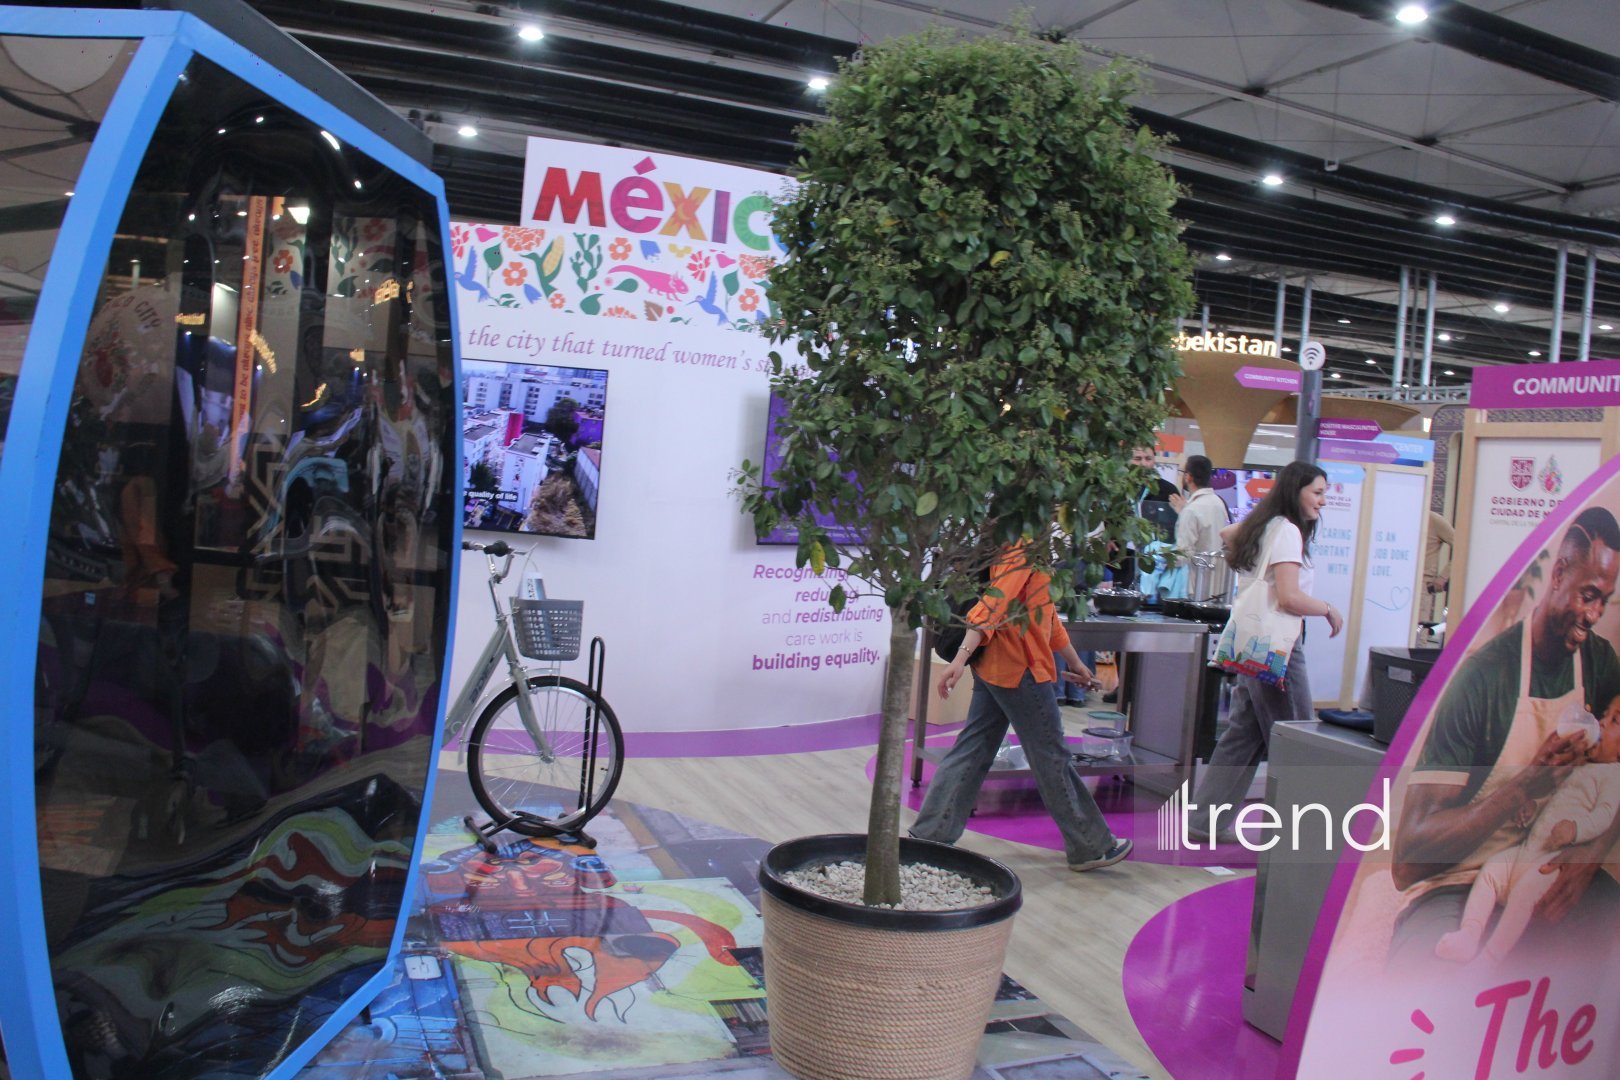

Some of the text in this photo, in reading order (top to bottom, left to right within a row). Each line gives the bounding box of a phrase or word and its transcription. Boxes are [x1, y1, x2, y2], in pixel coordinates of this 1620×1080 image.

[468, 325, 500, 347] the
[506, 329, 546, 357] city
[552, 332, 595, 355] that
[602, 340, 672, 363] turned
[468, 491, 494, 500] quality
[1491, 496, 1545, 508] GOBIERNO
[1490, 507, 1525, 517] CIUDAD
[1527, 509, 1540, 518] DE
[1322, 528, 1351, 541] CARING
[1386, 532, 1396, 542] AN
[1309, 544, 1351, 558] PORTANT
[1374, 548, 1409, 561] JOB DONE
[1327, 563, 1349, 575] WITH
[762, 605, 883, 624] and redistributing
[786, 628, 863, 646] care work is
[752, 646, 880, 671] building equality.
[1475, 976, 1597, 1080] The
